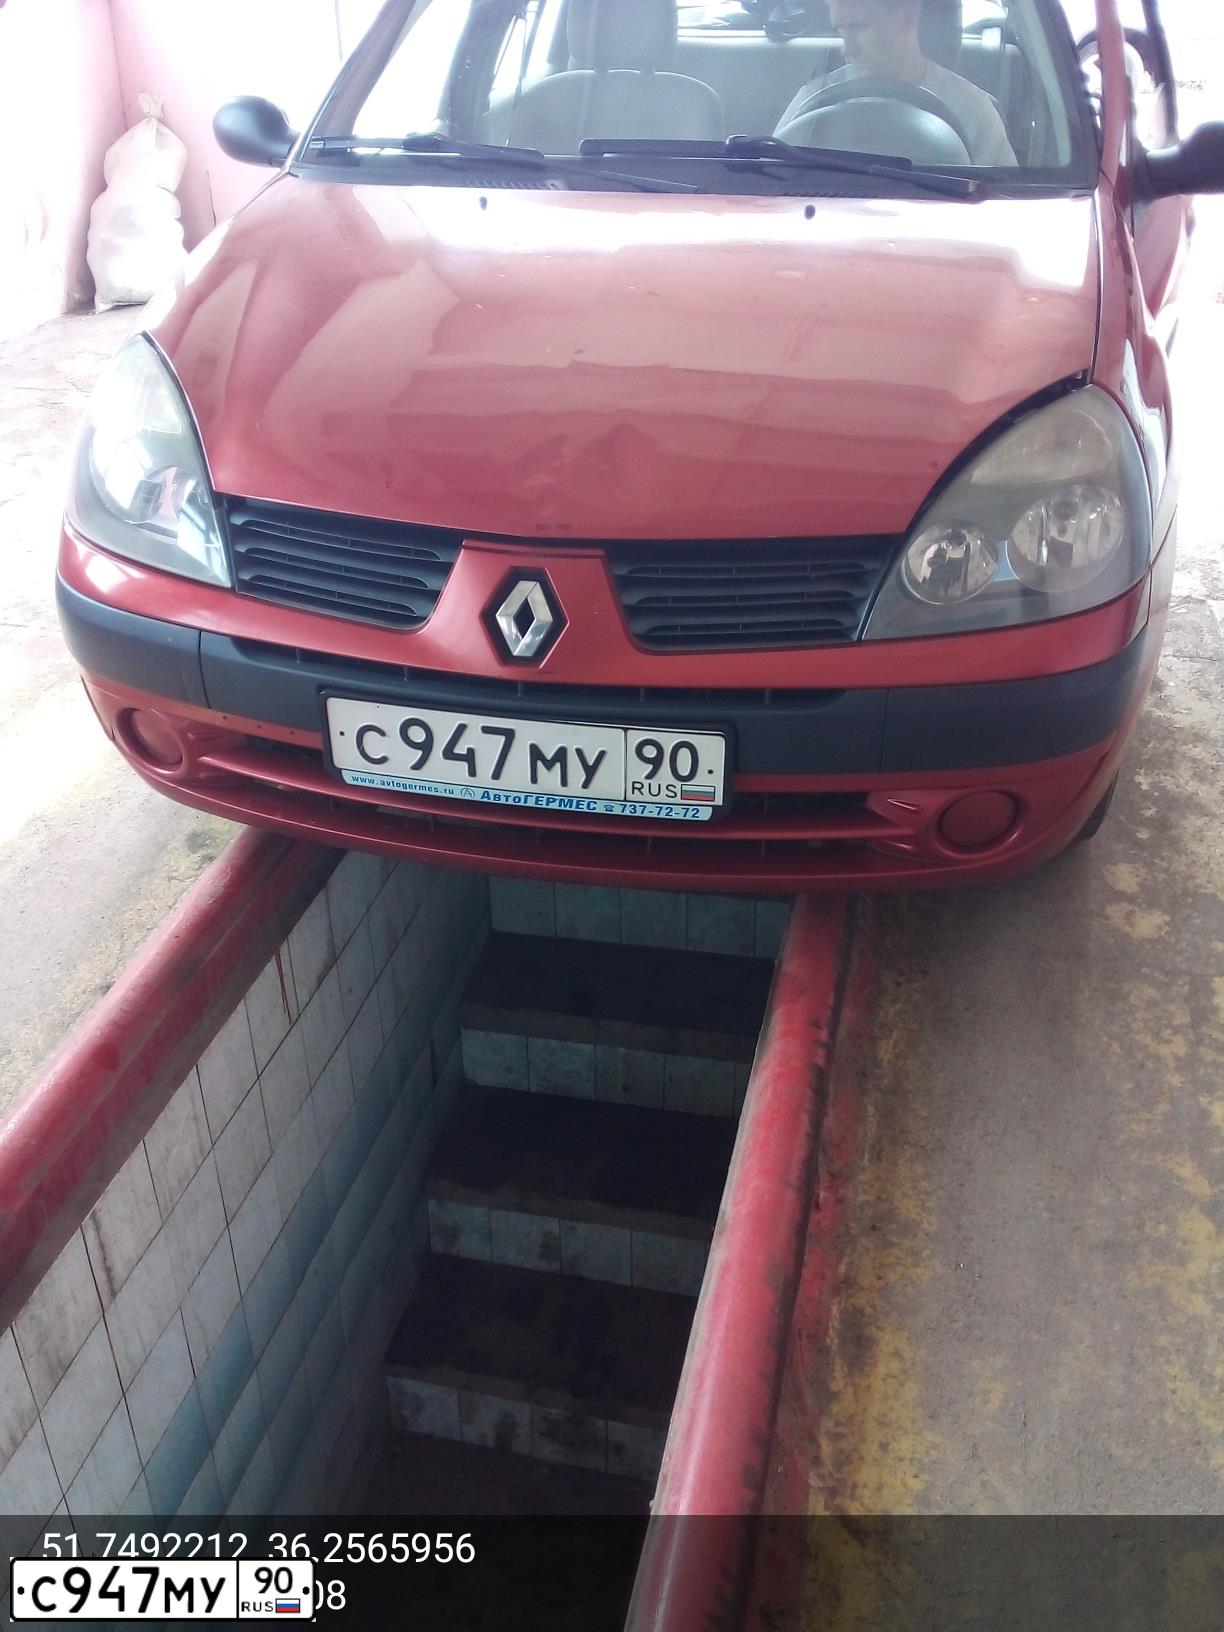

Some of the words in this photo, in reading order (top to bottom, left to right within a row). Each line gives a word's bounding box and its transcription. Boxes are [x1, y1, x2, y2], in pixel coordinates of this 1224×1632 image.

[354, 717, 608, 790] С947МУ
[634, 737, 700, 784] 90
[480, 789, 599, 812] АвтоГЕРМЕС
[631, 780, 679, 800] RUS
[618, 802, 701, 820] 737-72-72
